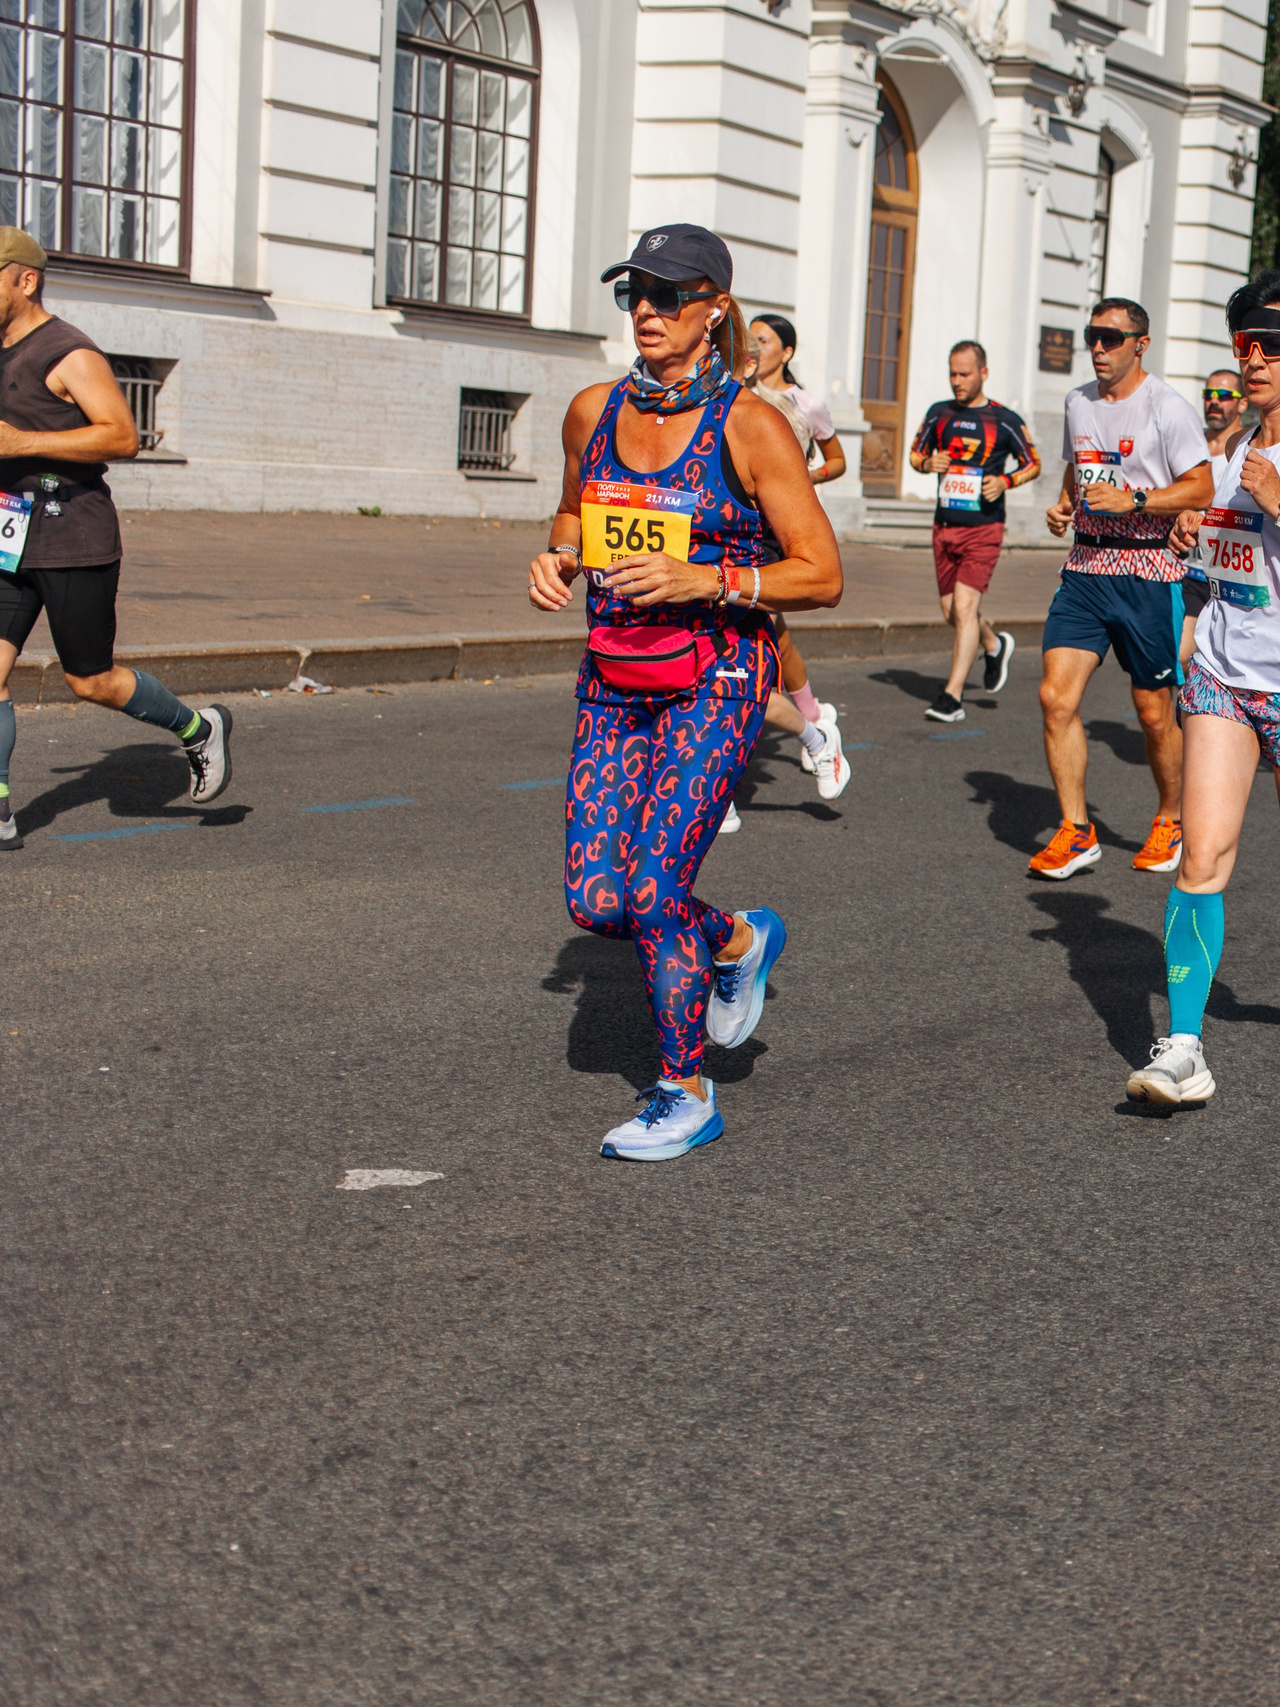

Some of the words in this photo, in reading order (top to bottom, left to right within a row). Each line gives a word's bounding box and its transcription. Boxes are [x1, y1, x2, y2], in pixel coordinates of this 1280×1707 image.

[597, 483, 616, 491] ПОЛУ
[943, 479, 975, 495] 6984
[597, 491, 630, 499] МАРАФОН
[645, 493, 662, 504] 21,1
[604, 515, 665, 553] 565
[1207, 538, 1255, 574] 7658
